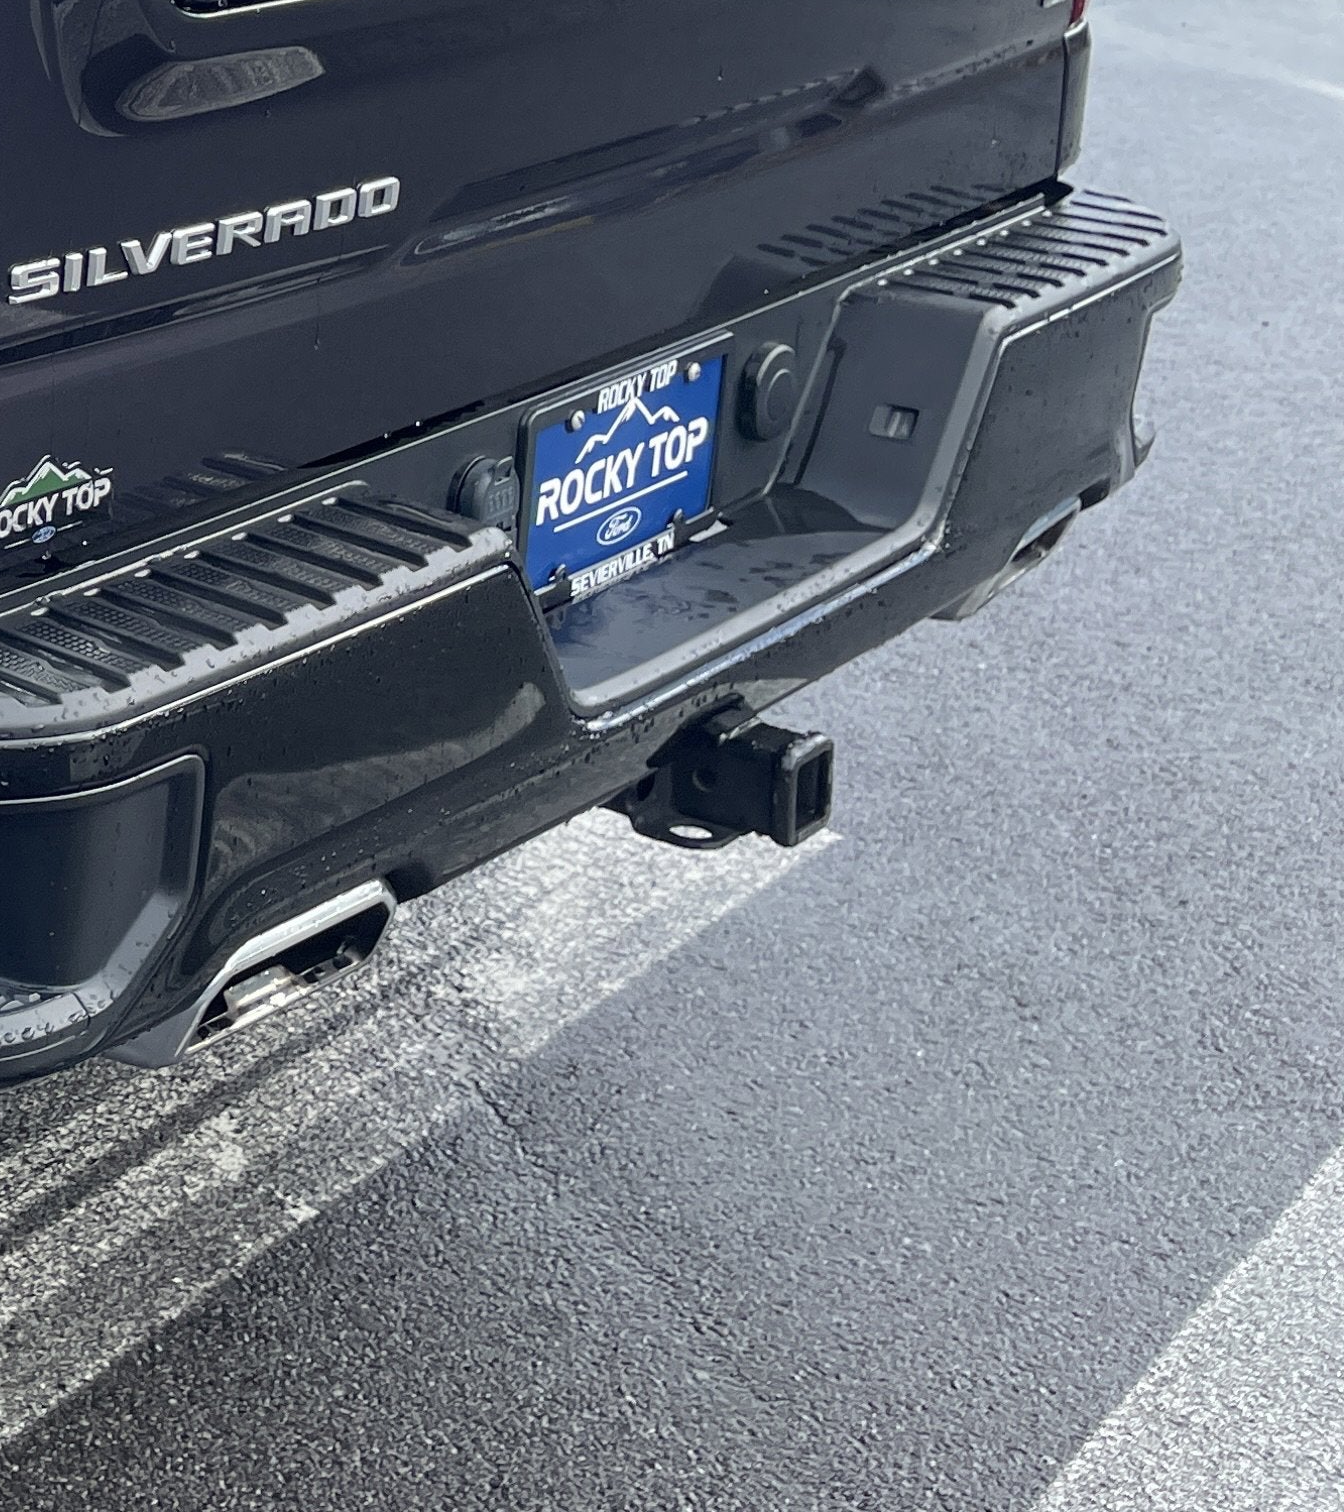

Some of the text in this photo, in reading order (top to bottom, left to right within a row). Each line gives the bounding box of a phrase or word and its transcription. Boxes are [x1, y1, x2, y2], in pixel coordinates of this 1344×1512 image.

[9, 175, 401, 304] SILVERADO
[597, 359, 679, 414] ROCKY TOP
[62, 477, 111, 516] TOP
[535, 416, 709, 526] ROCKY TOP
[656, 530, 675, 555] TN
